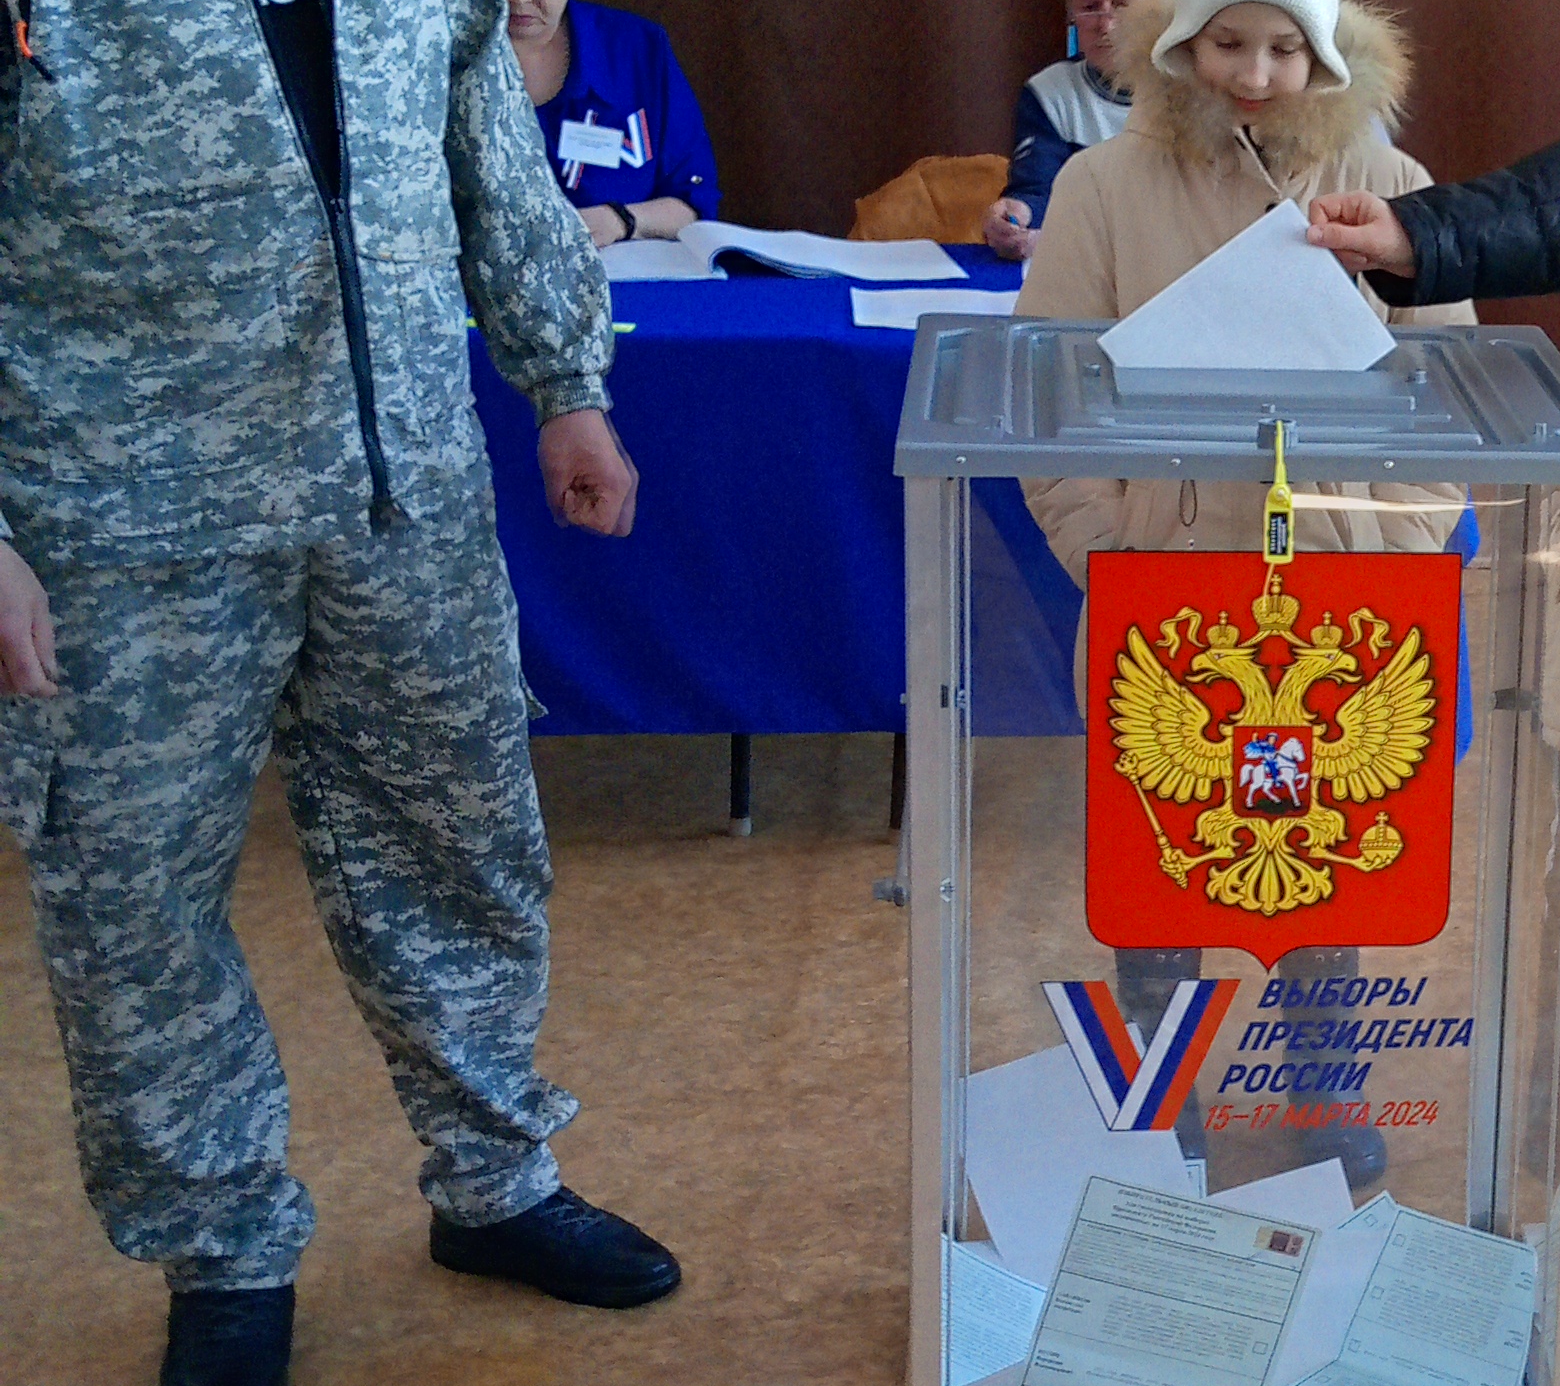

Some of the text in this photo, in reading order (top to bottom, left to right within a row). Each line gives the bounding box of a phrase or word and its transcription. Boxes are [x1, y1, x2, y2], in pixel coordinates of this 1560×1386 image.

[1257, 976, 1429, 1009] ВЫБОРЫ
[1237, 1017, 1476, 1054] ПРЕЗИДЕНТА
[1217, 1061, 1374, 1094] РОССИИ
[1278, 1100, 1372, 1130] МАРТА
[1373, 1098, 1440, 1127] 2024
